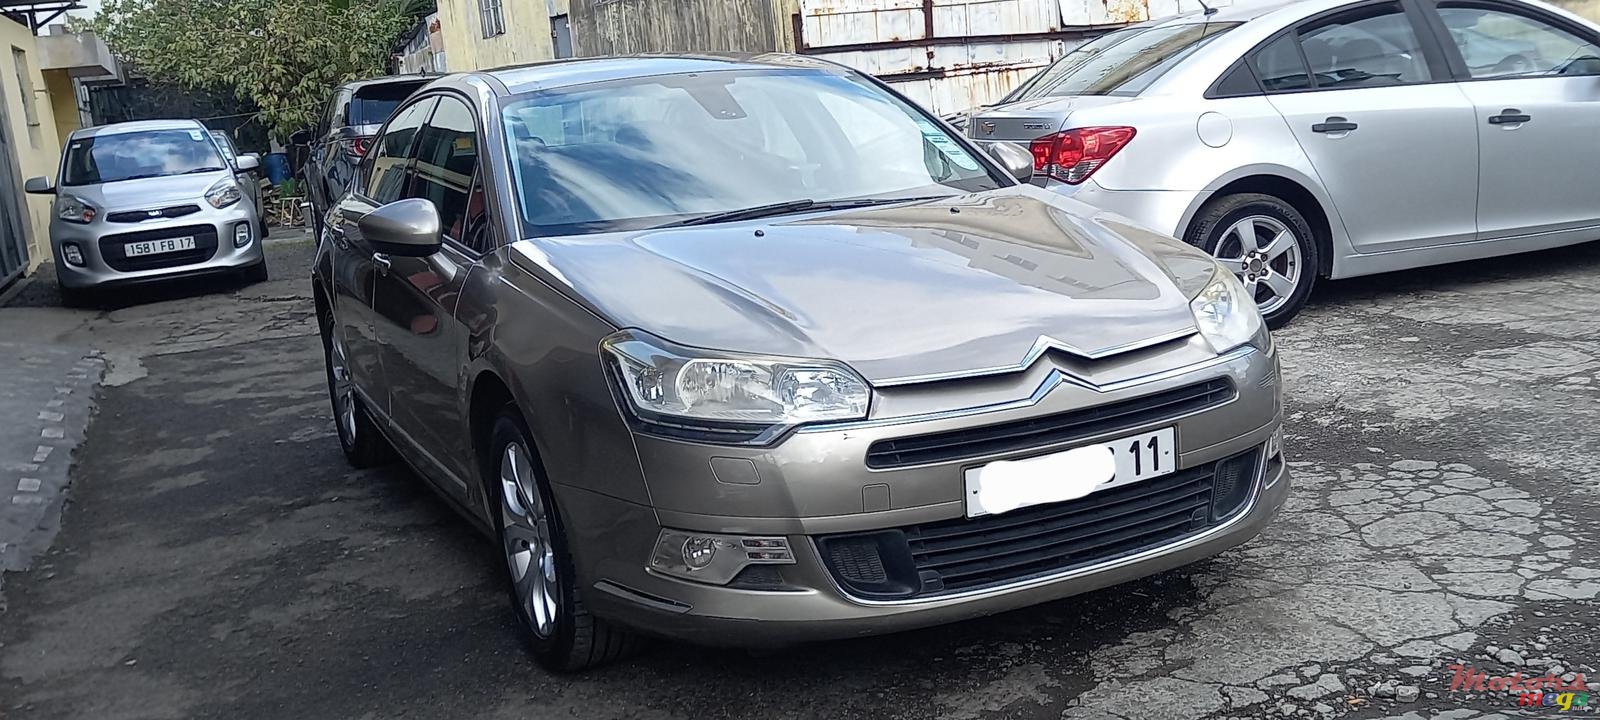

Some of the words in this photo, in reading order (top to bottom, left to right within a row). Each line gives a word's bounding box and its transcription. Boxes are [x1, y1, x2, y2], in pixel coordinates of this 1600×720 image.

[130, 242, 156, 254] 1581
[160, 240, 175, 251] FB
[179, 238, 191, 248] 17
[1129, 435, 1158, 476] 11
